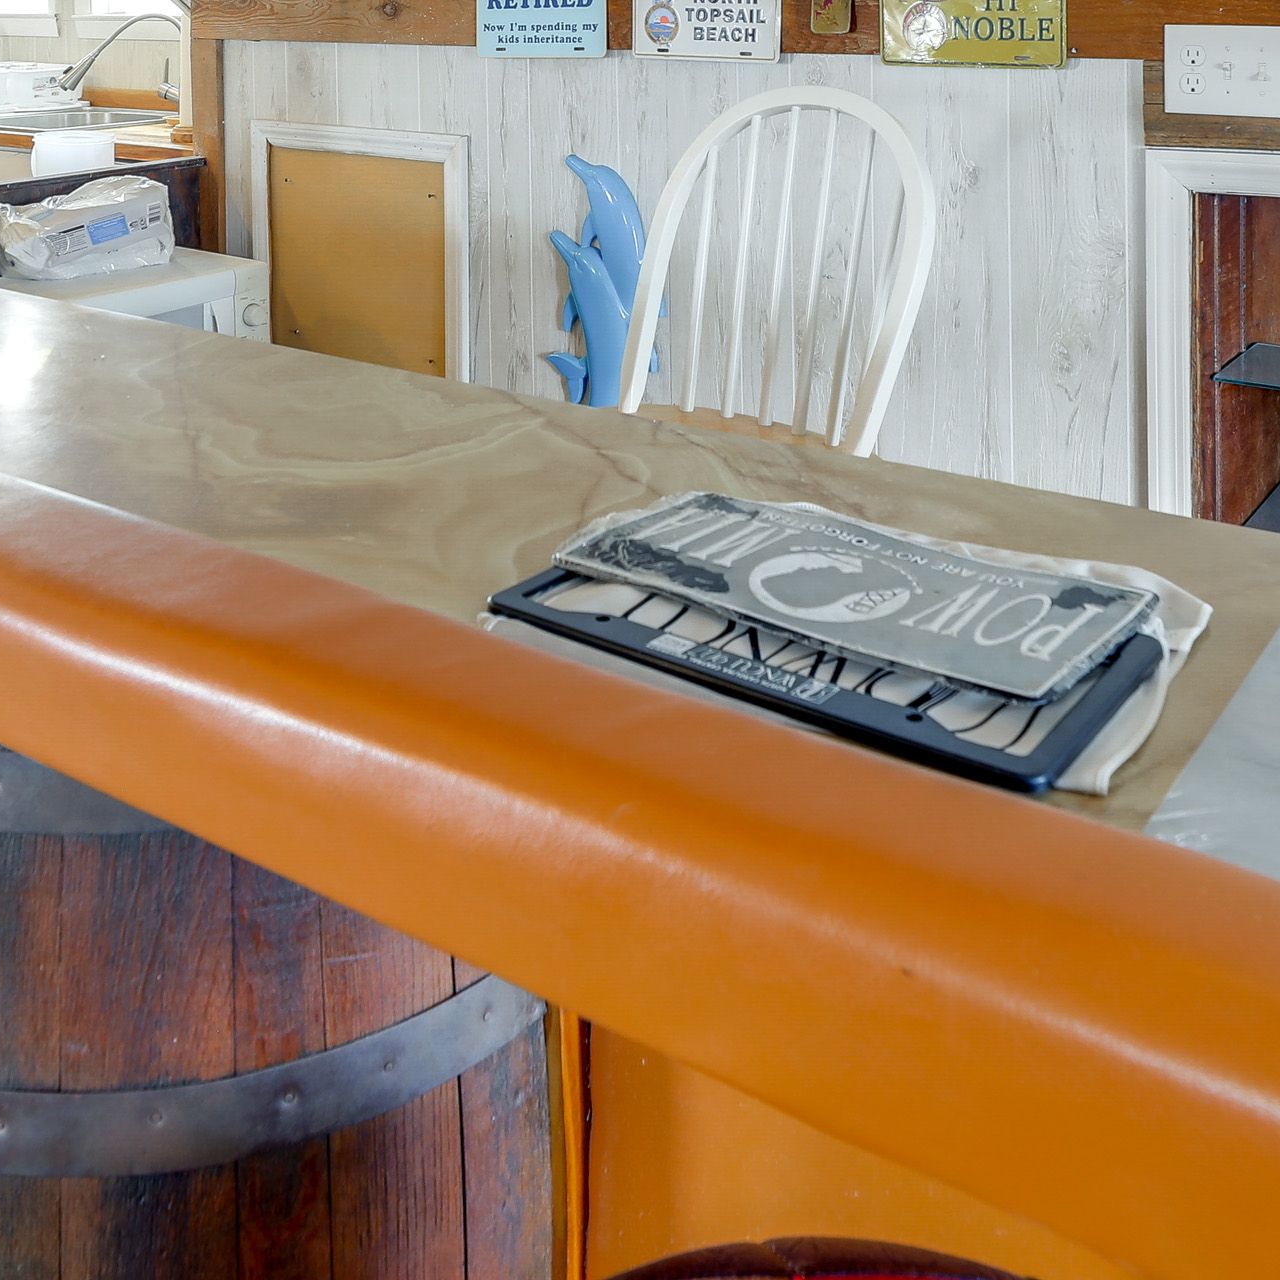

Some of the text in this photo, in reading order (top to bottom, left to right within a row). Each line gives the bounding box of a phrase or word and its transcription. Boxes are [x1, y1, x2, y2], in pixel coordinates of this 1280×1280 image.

[685, 7, 767, 24] TOPSAIL
[483, 22, 599, 33] Now I'm spending my
[693, 26, 757, 43] BEACH
[951, 16, 1056, 42] NOBLE
[497, 35, 583, 44] kids inheritance
[880, 549, 928, 565] NOT
[931, 561, 978, 580] ARE
[628, 503, 1105, 662] POW MIA
[980, 573, 1025, 589] YOU
